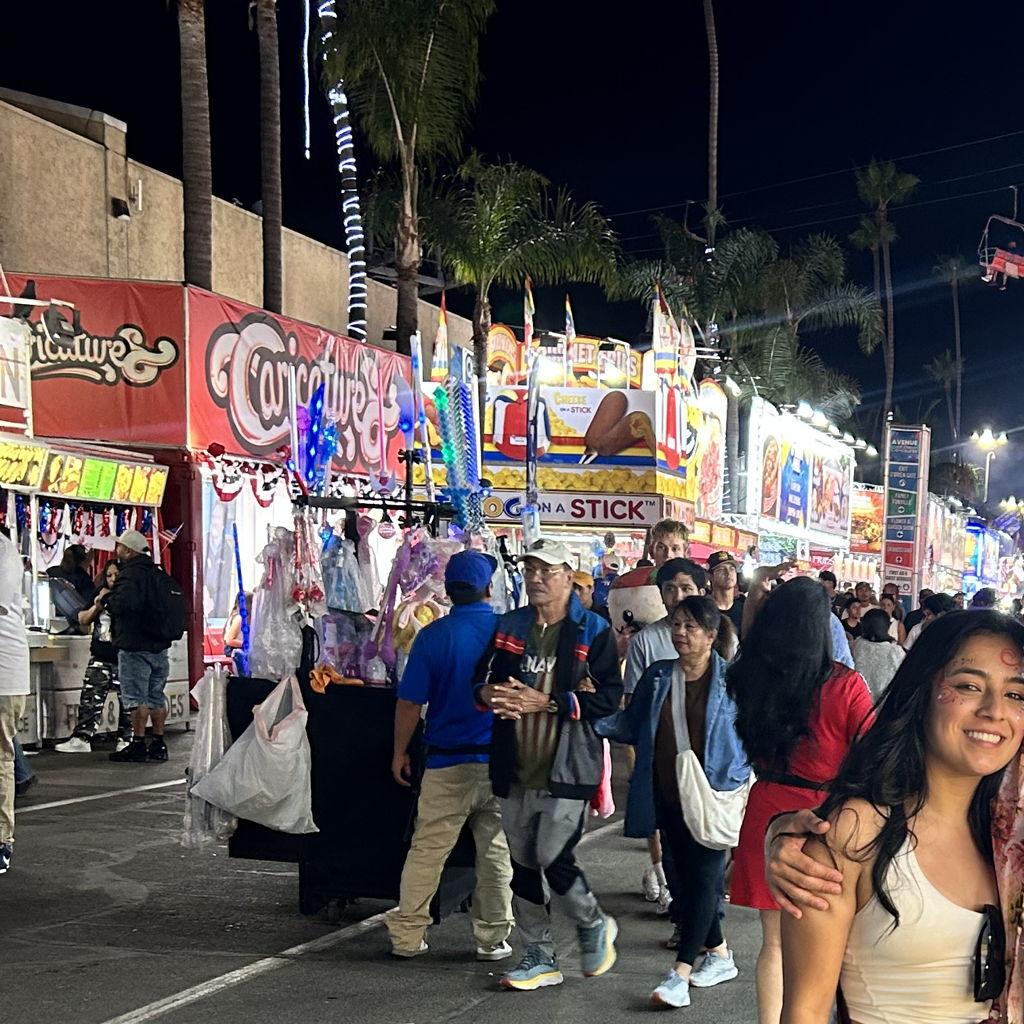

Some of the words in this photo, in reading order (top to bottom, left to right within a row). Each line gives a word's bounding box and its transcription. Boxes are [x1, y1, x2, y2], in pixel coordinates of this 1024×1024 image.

[206, 312, 402, 470] Carcatures
[570, 406, 592, 414] STICK
[483, 495, 522, 519] OG
[555, 503, 566, 513] A
